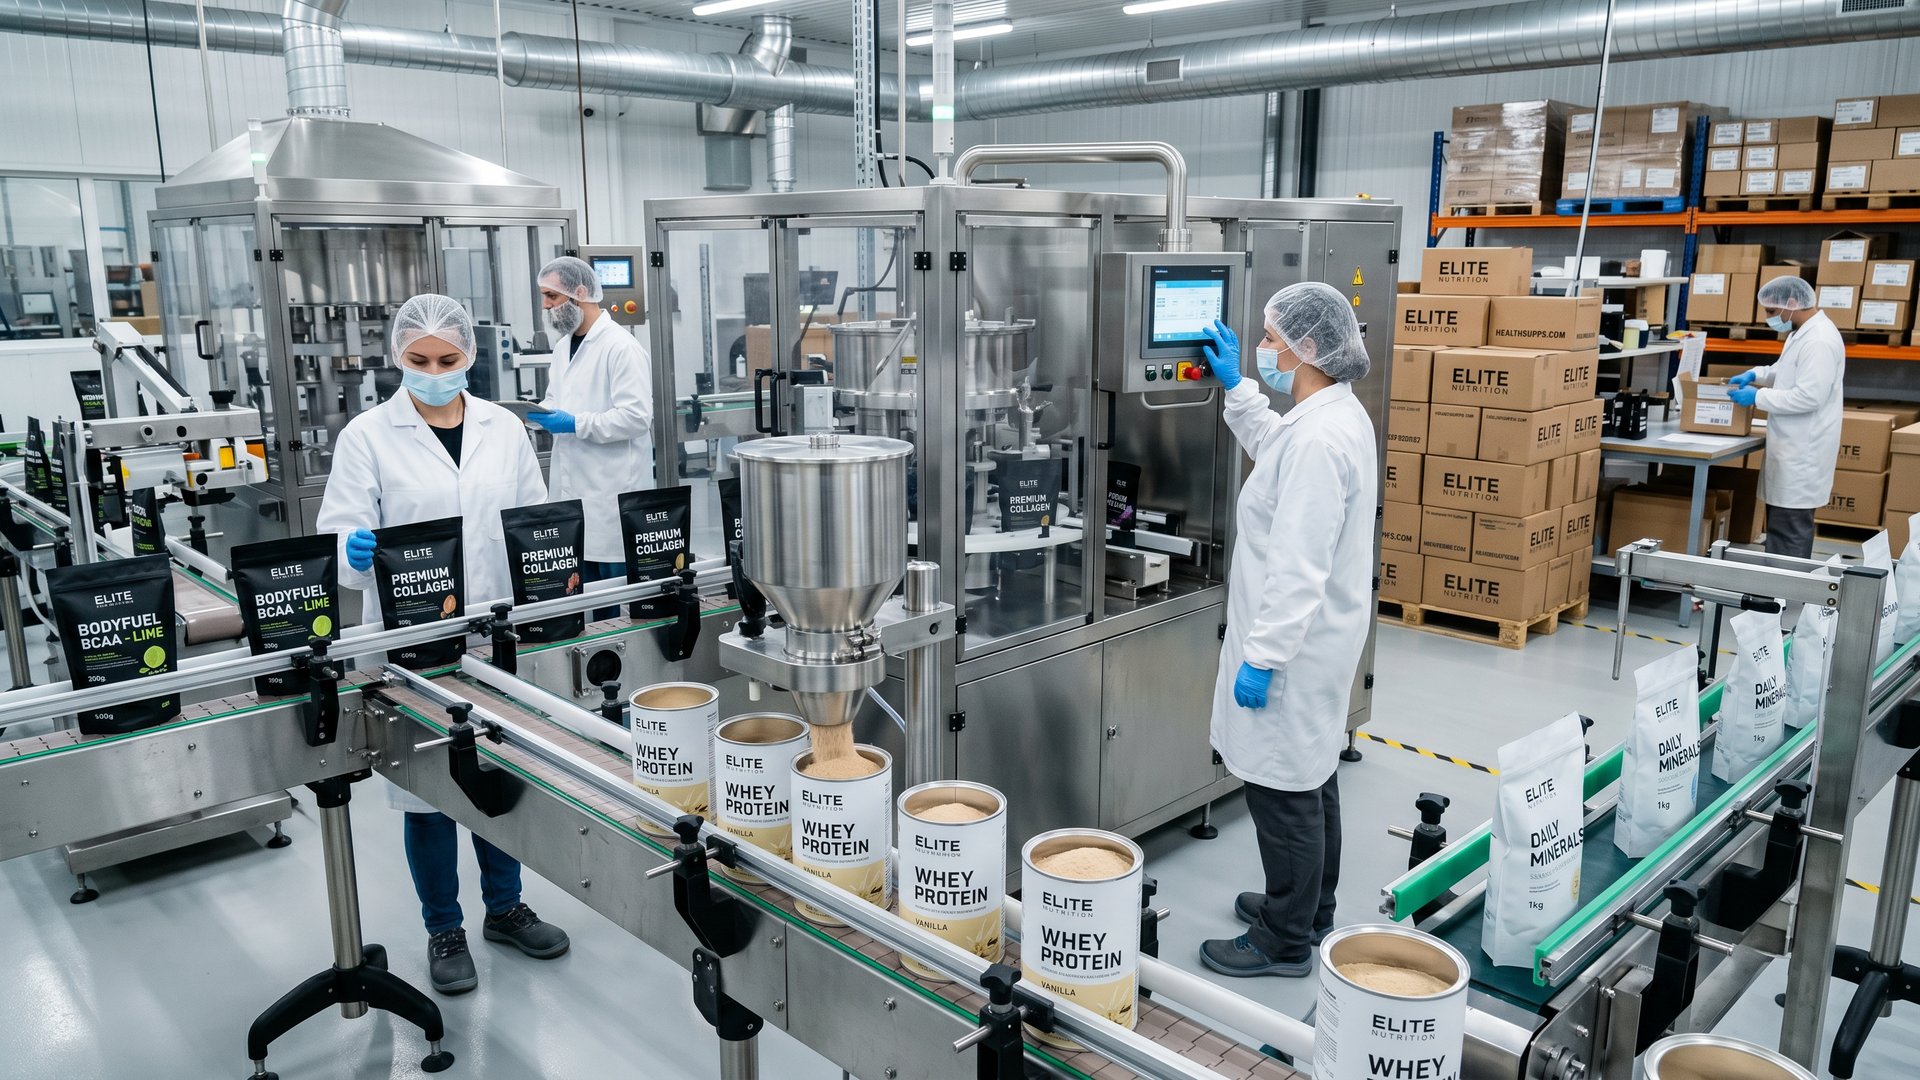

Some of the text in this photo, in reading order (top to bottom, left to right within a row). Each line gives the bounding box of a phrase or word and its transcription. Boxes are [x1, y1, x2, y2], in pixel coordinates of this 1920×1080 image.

[1440, 262, 1489, 275] ELITE
[1405, 310, 1458, 325] ELITE
[1404, 325, 1458, 333] NUTRITION
[1495, 329, 1566, 339] HEALTHSUPPS.COM
[1453, 368, 1509, 386] ELITE
[1564, 366, 1589, 383] ELITE
[1452, 384, 1508, 395] NUTRITION
[1538, 423, 1561, 442] ELITE
[1574, 416, 1597, 432] ELITE
[1444, 473, 1499, 493] ELITE
[1443, 489, 1499, 502] NUTRITION
[1828, 496, 1855, 508] ITE
[646, 511, 668, 521] ELITE
[1010, 503, 1050, 513] COLLAGEN
[1567, 514, 1590, 533] ELITE
[533, 528, 559, 539] ELITE
[635, 528, 681, 544] PREMIUM
[1531, 526, 1554, 546] ELITE
[404, 547, 433, 559] ELITE
[522, 546, 574, 562] PREMIUM
[636, 538, 685, 555] COLLAGEN
[271, 564, 303, 577] ELITE
[523, 557, 578, 575] COLLAGEN
[392, 566, 449, 586] PREMIUM
[393, 578, 455, 598] COLLAGEN
[1444, 574, 1499, 597] ELITE
[94, 590, 133, 605] ELITE
[255, 584, 327, 606] BODYFUEL
[1444, 590, 1499, 604] NUTRITION
[257, 604, 294, 619] BCAA
[78, 613, 161, 636] BODYFUEL
[81, 634, 122, 650] BCAA
[1755, 675, 1777, 695] DAILY
[1656, 698, 1678, 718] ELITE
[636, 718, 666, 731] ELITE
[1659, 733, 1682, 756] DAILY
[1754, 735, 1765, 743] 1kg
[636, 742, 679, 760] WHEY
[1659, 740, 1700, 773] MINERALS
[636, 758, 692, 775] PROTEIN
[726, 755, 763, 768] ELITE
[725, 781, 775, 800] WHEY
[802, 790, 842, 806] ELITE
[1525, 778, 1554, 803] ELITE
[726, 799, 789, 816] PROTEIN
[1657, 801, 1670, 810] 1kg
[727, 827, 754, 838] VANILLA
[802, 818, 855, 839] WHEY
[1530, 820, 1560, 848] DAILY
[802, 836, 869, 856] PROTEIN
[915, 834, 960, 851] ELITE
[1530, 828, 1584, 867] MINERALS
[803, 866, 832, 879] VANILLA
[915, 866, 974, 888] WHEY
[915, 885, 988, 906] PROTEIN
[1043, 892, 1093, 911] ELITE
[1529, 901, 1544, 910] 1kg
[915, 918, 948, 931] VANILLA
[1041, 925, 1107, 951] WHEY
[1041, 946, 1122, 970] PROTEIN
[1041, 981, 1076, 997] VANILLA
[1372, 1014, 1435, 1033] ELITE
[1372, 1030, 1435, 1041] NUTRITION
[1368, 1053, 1445, 1079] WHEY
